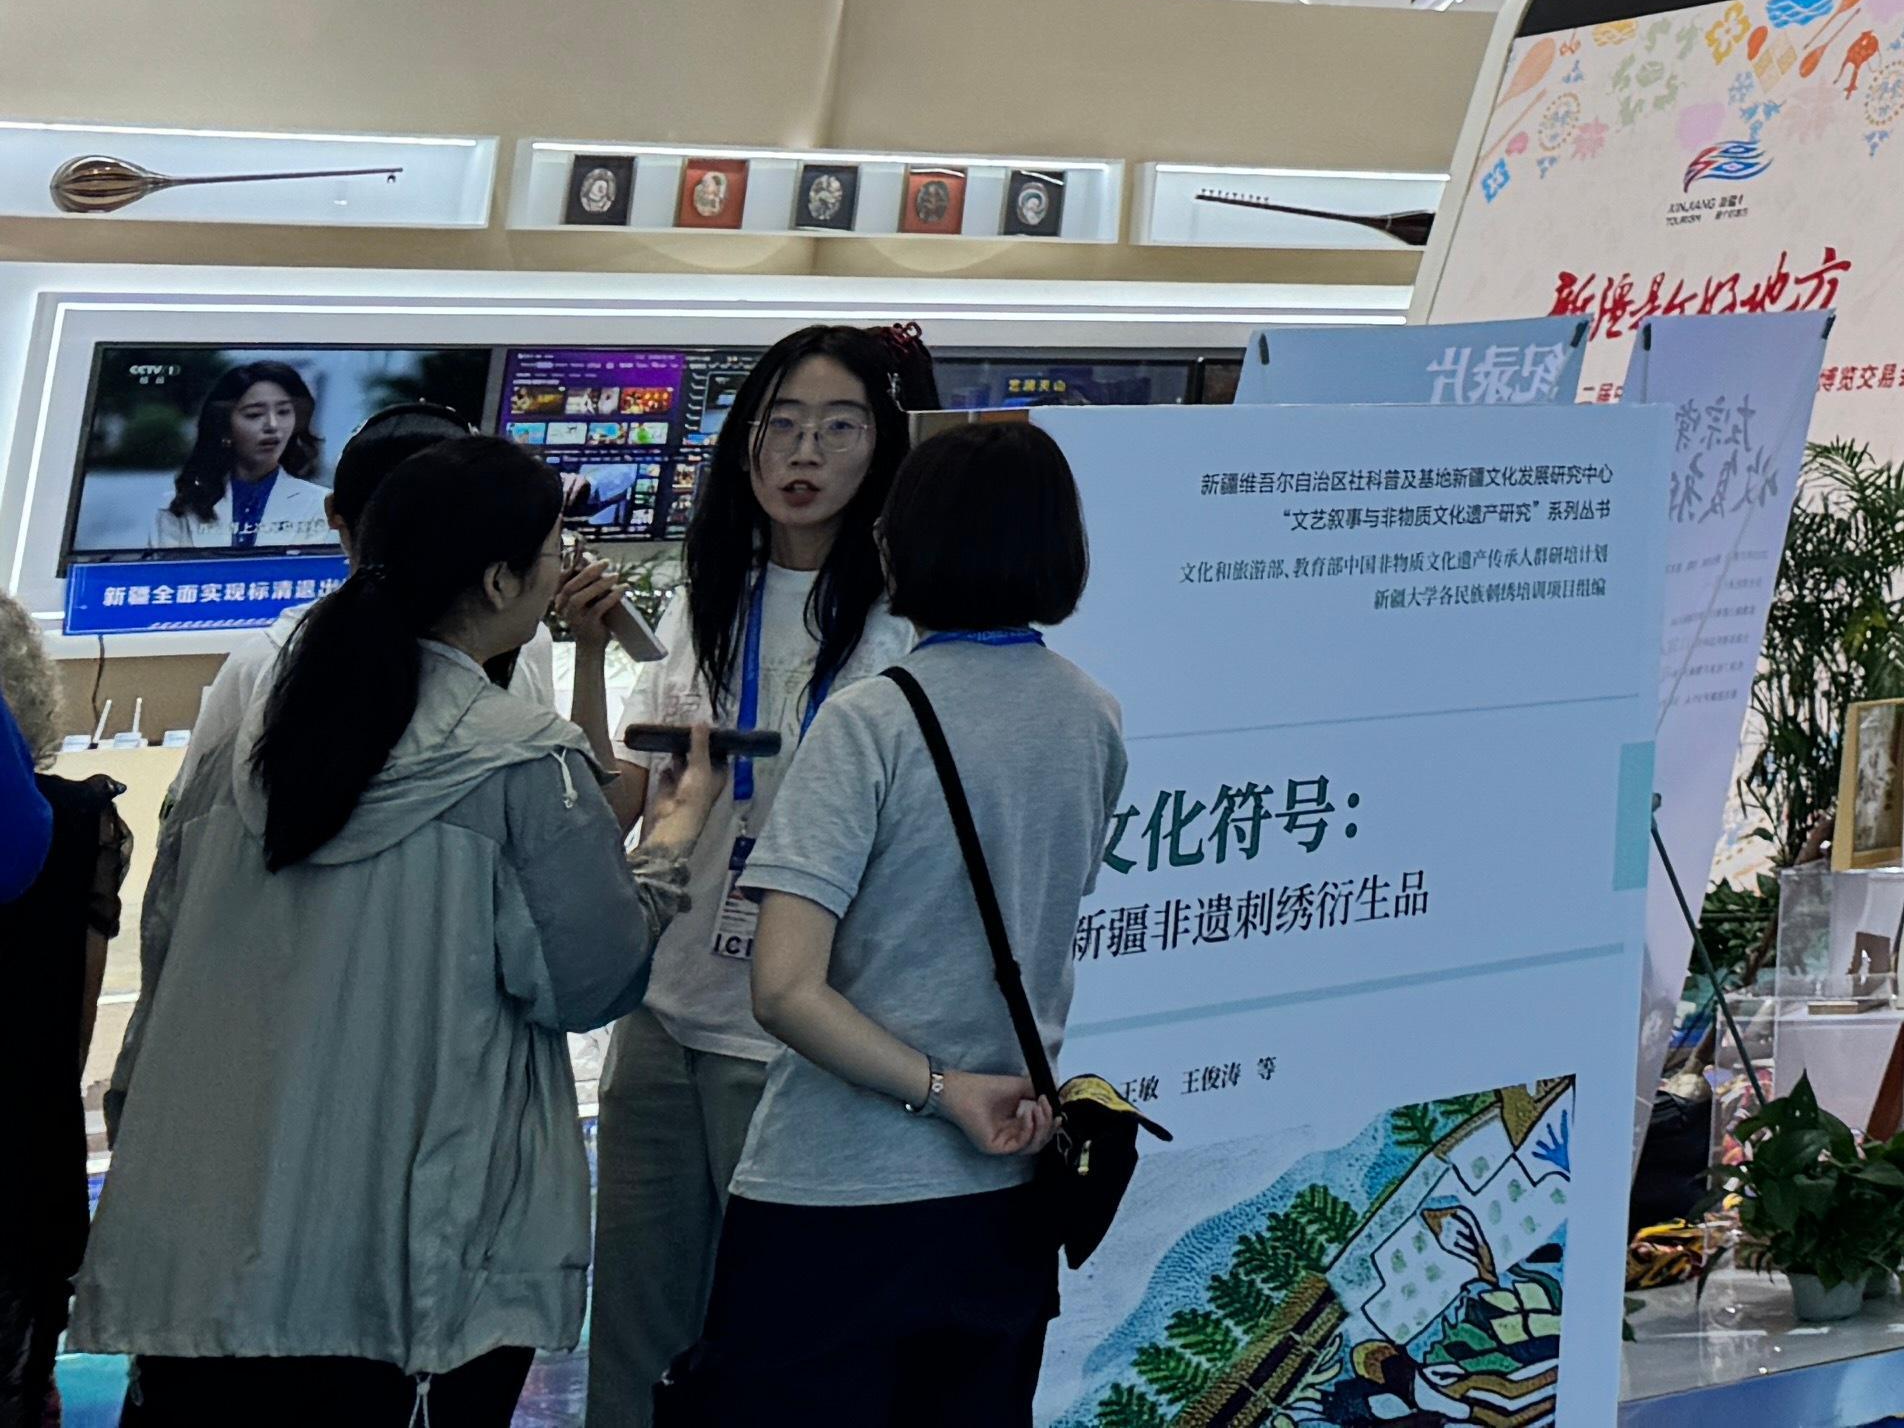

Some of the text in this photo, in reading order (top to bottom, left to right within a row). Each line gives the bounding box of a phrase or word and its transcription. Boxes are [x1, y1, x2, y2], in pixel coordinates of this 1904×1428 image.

[1072, 869, 1430, 962] 新疆非遗刺绣衍生品
[1255, 1055, 1278, 1083] 等
